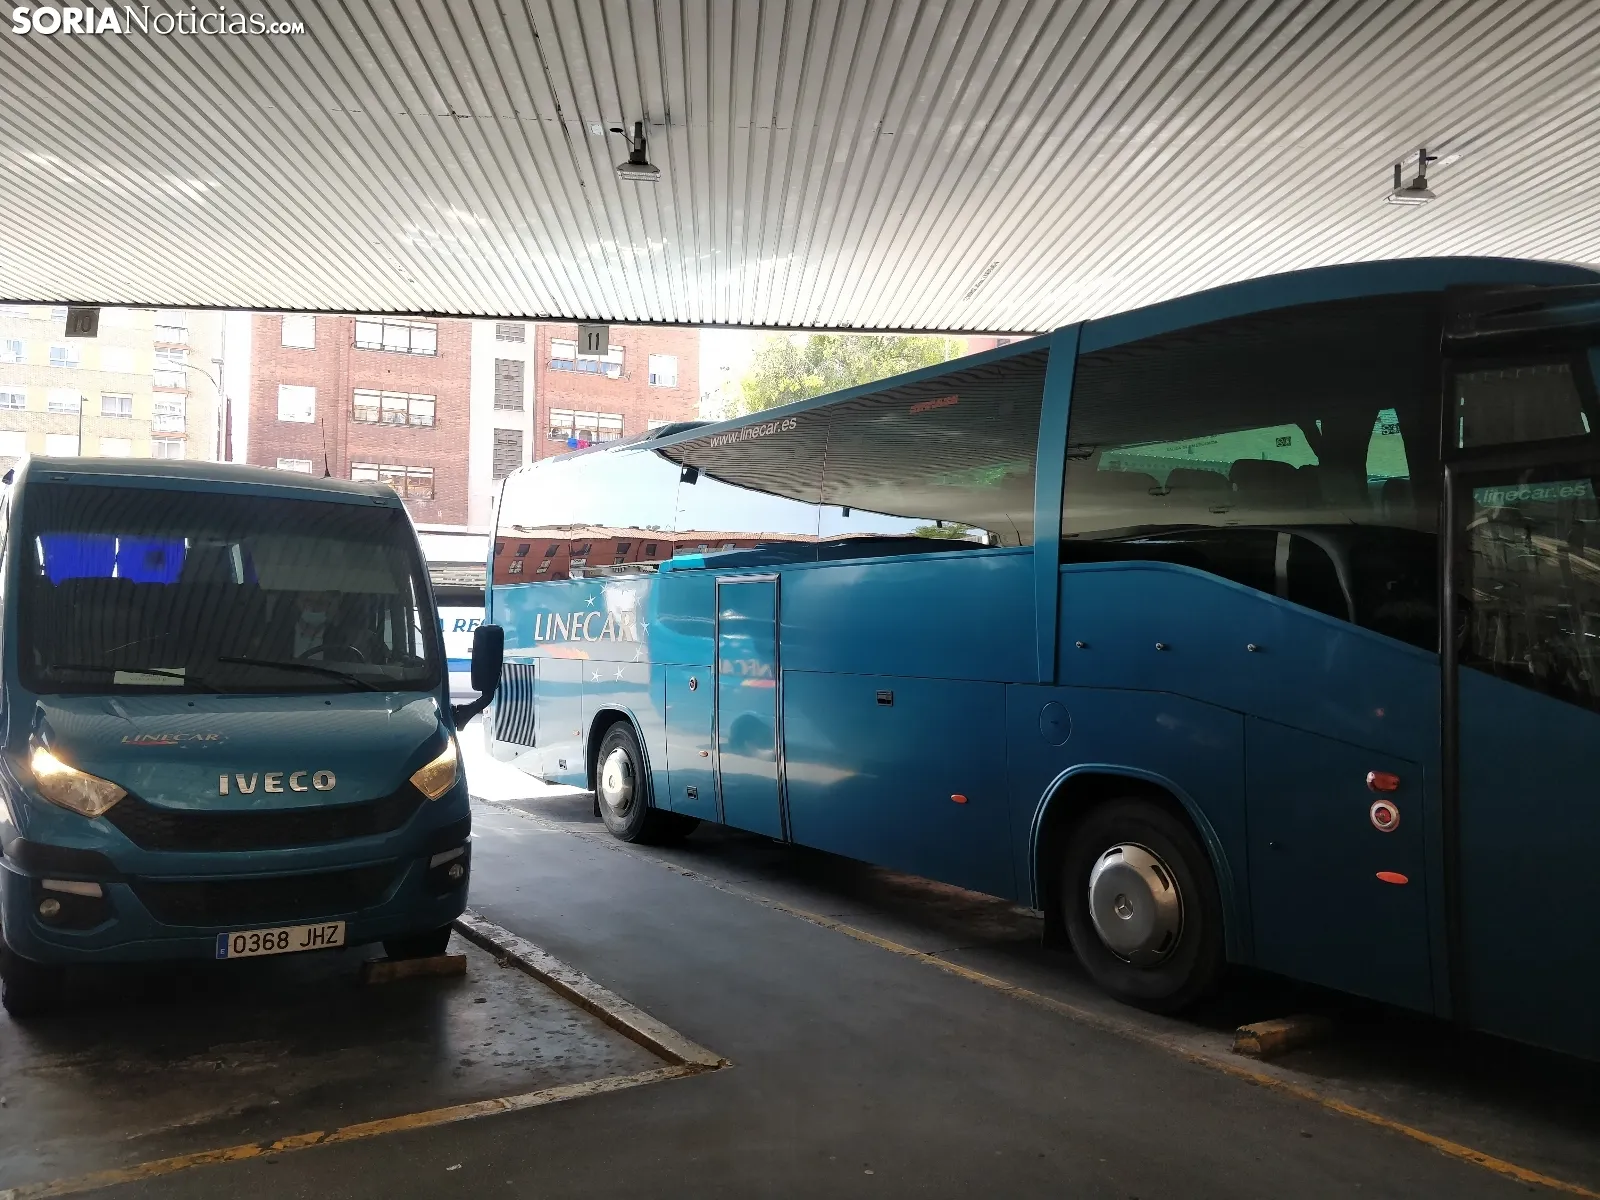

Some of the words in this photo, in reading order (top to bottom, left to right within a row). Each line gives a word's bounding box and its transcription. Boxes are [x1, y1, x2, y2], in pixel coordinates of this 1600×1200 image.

[587, 332, 600, 350] 11
[710, 417, 797, 448] www.linecar.es
[534, 610, 637, 642] LINECAR
[121, 732, 220, 743] LINECAR
[218, 770, 337, 796] IVECO
[233, 930, 289, 954] 0368
[300, 925, 339, 947] JHZ
